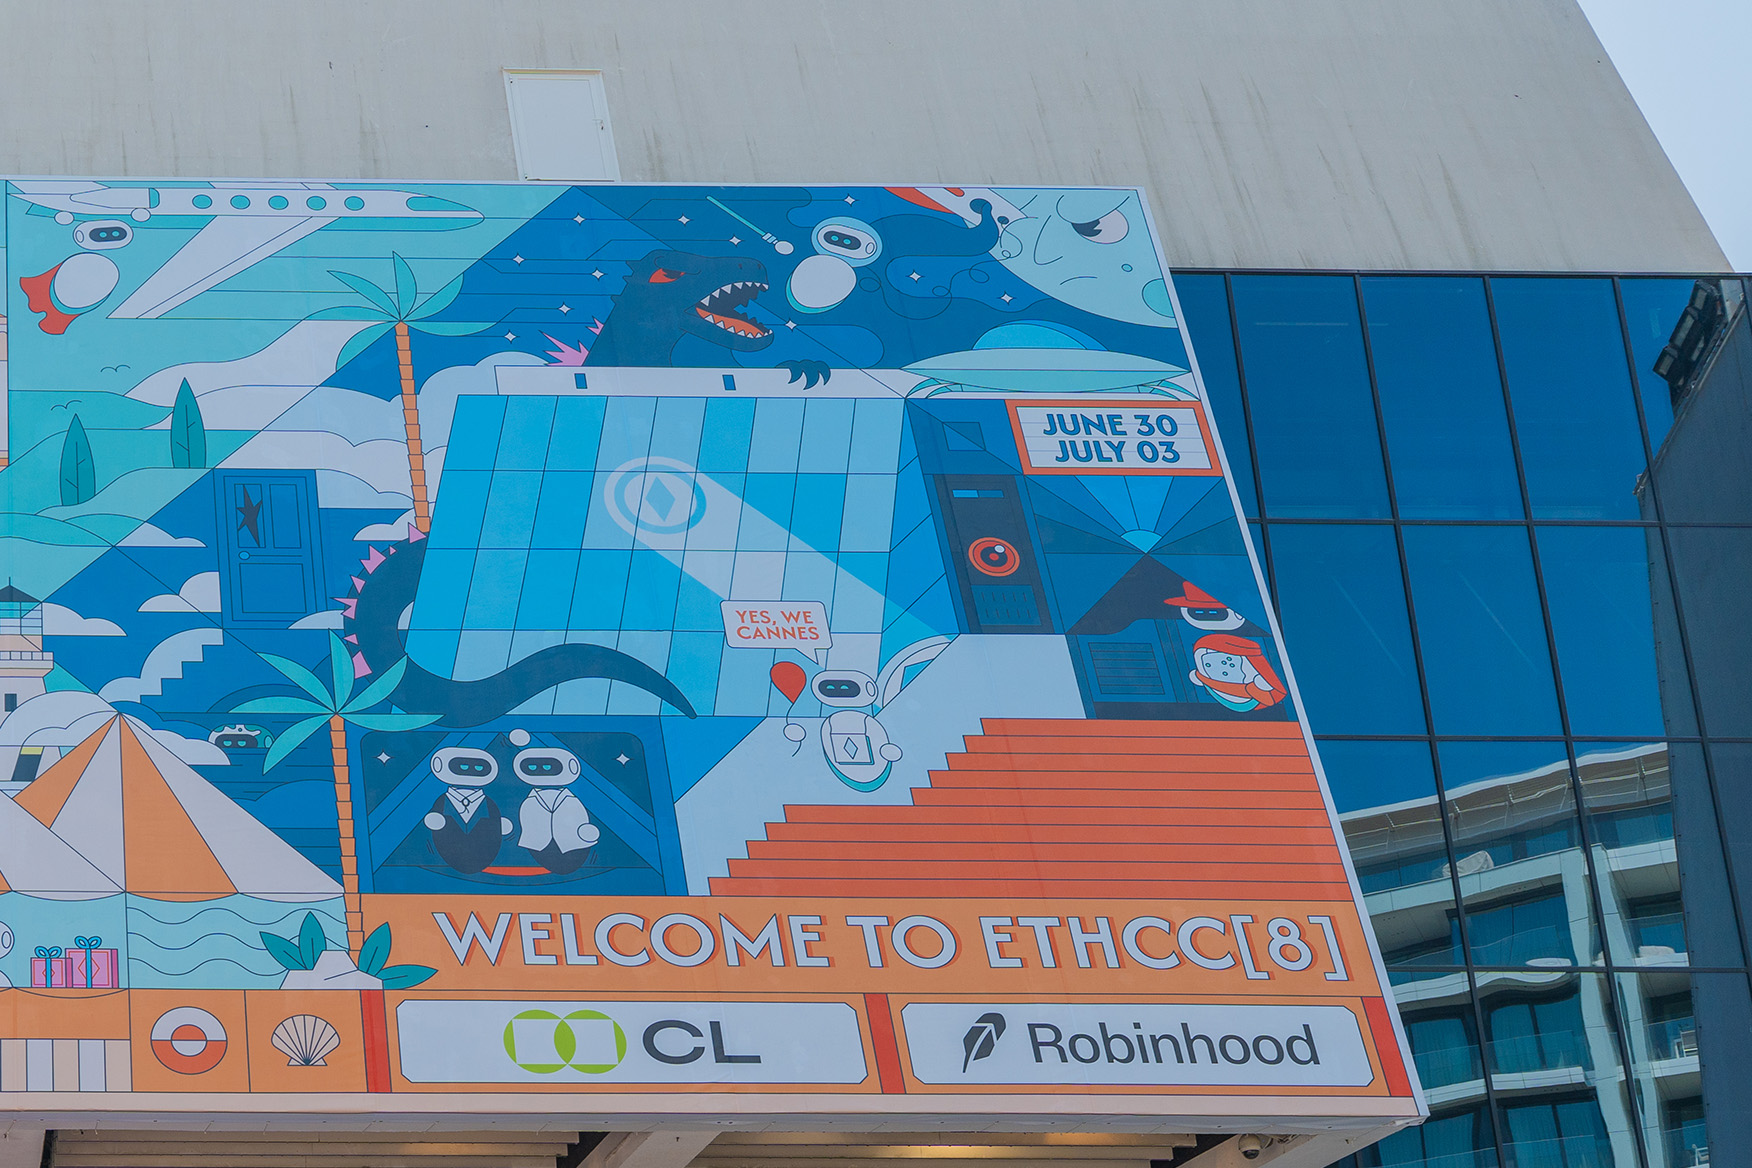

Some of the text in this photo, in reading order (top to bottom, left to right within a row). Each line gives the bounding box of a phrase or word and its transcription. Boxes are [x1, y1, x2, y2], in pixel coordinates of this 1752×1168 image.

[1043, 413, 1178, 437] JUNE 30
[1055, 440, 1180, 463] JULY 03
[735, 610, 814, 626] YES, WE
[736, 626, 820, 640] CANNES
[431, 910, 1355, 982] WELCOME TO ETHCC[8]
[642, 1019, 762, 1065] CL
[1026, 1021, 1321, 1066] Robinhood
